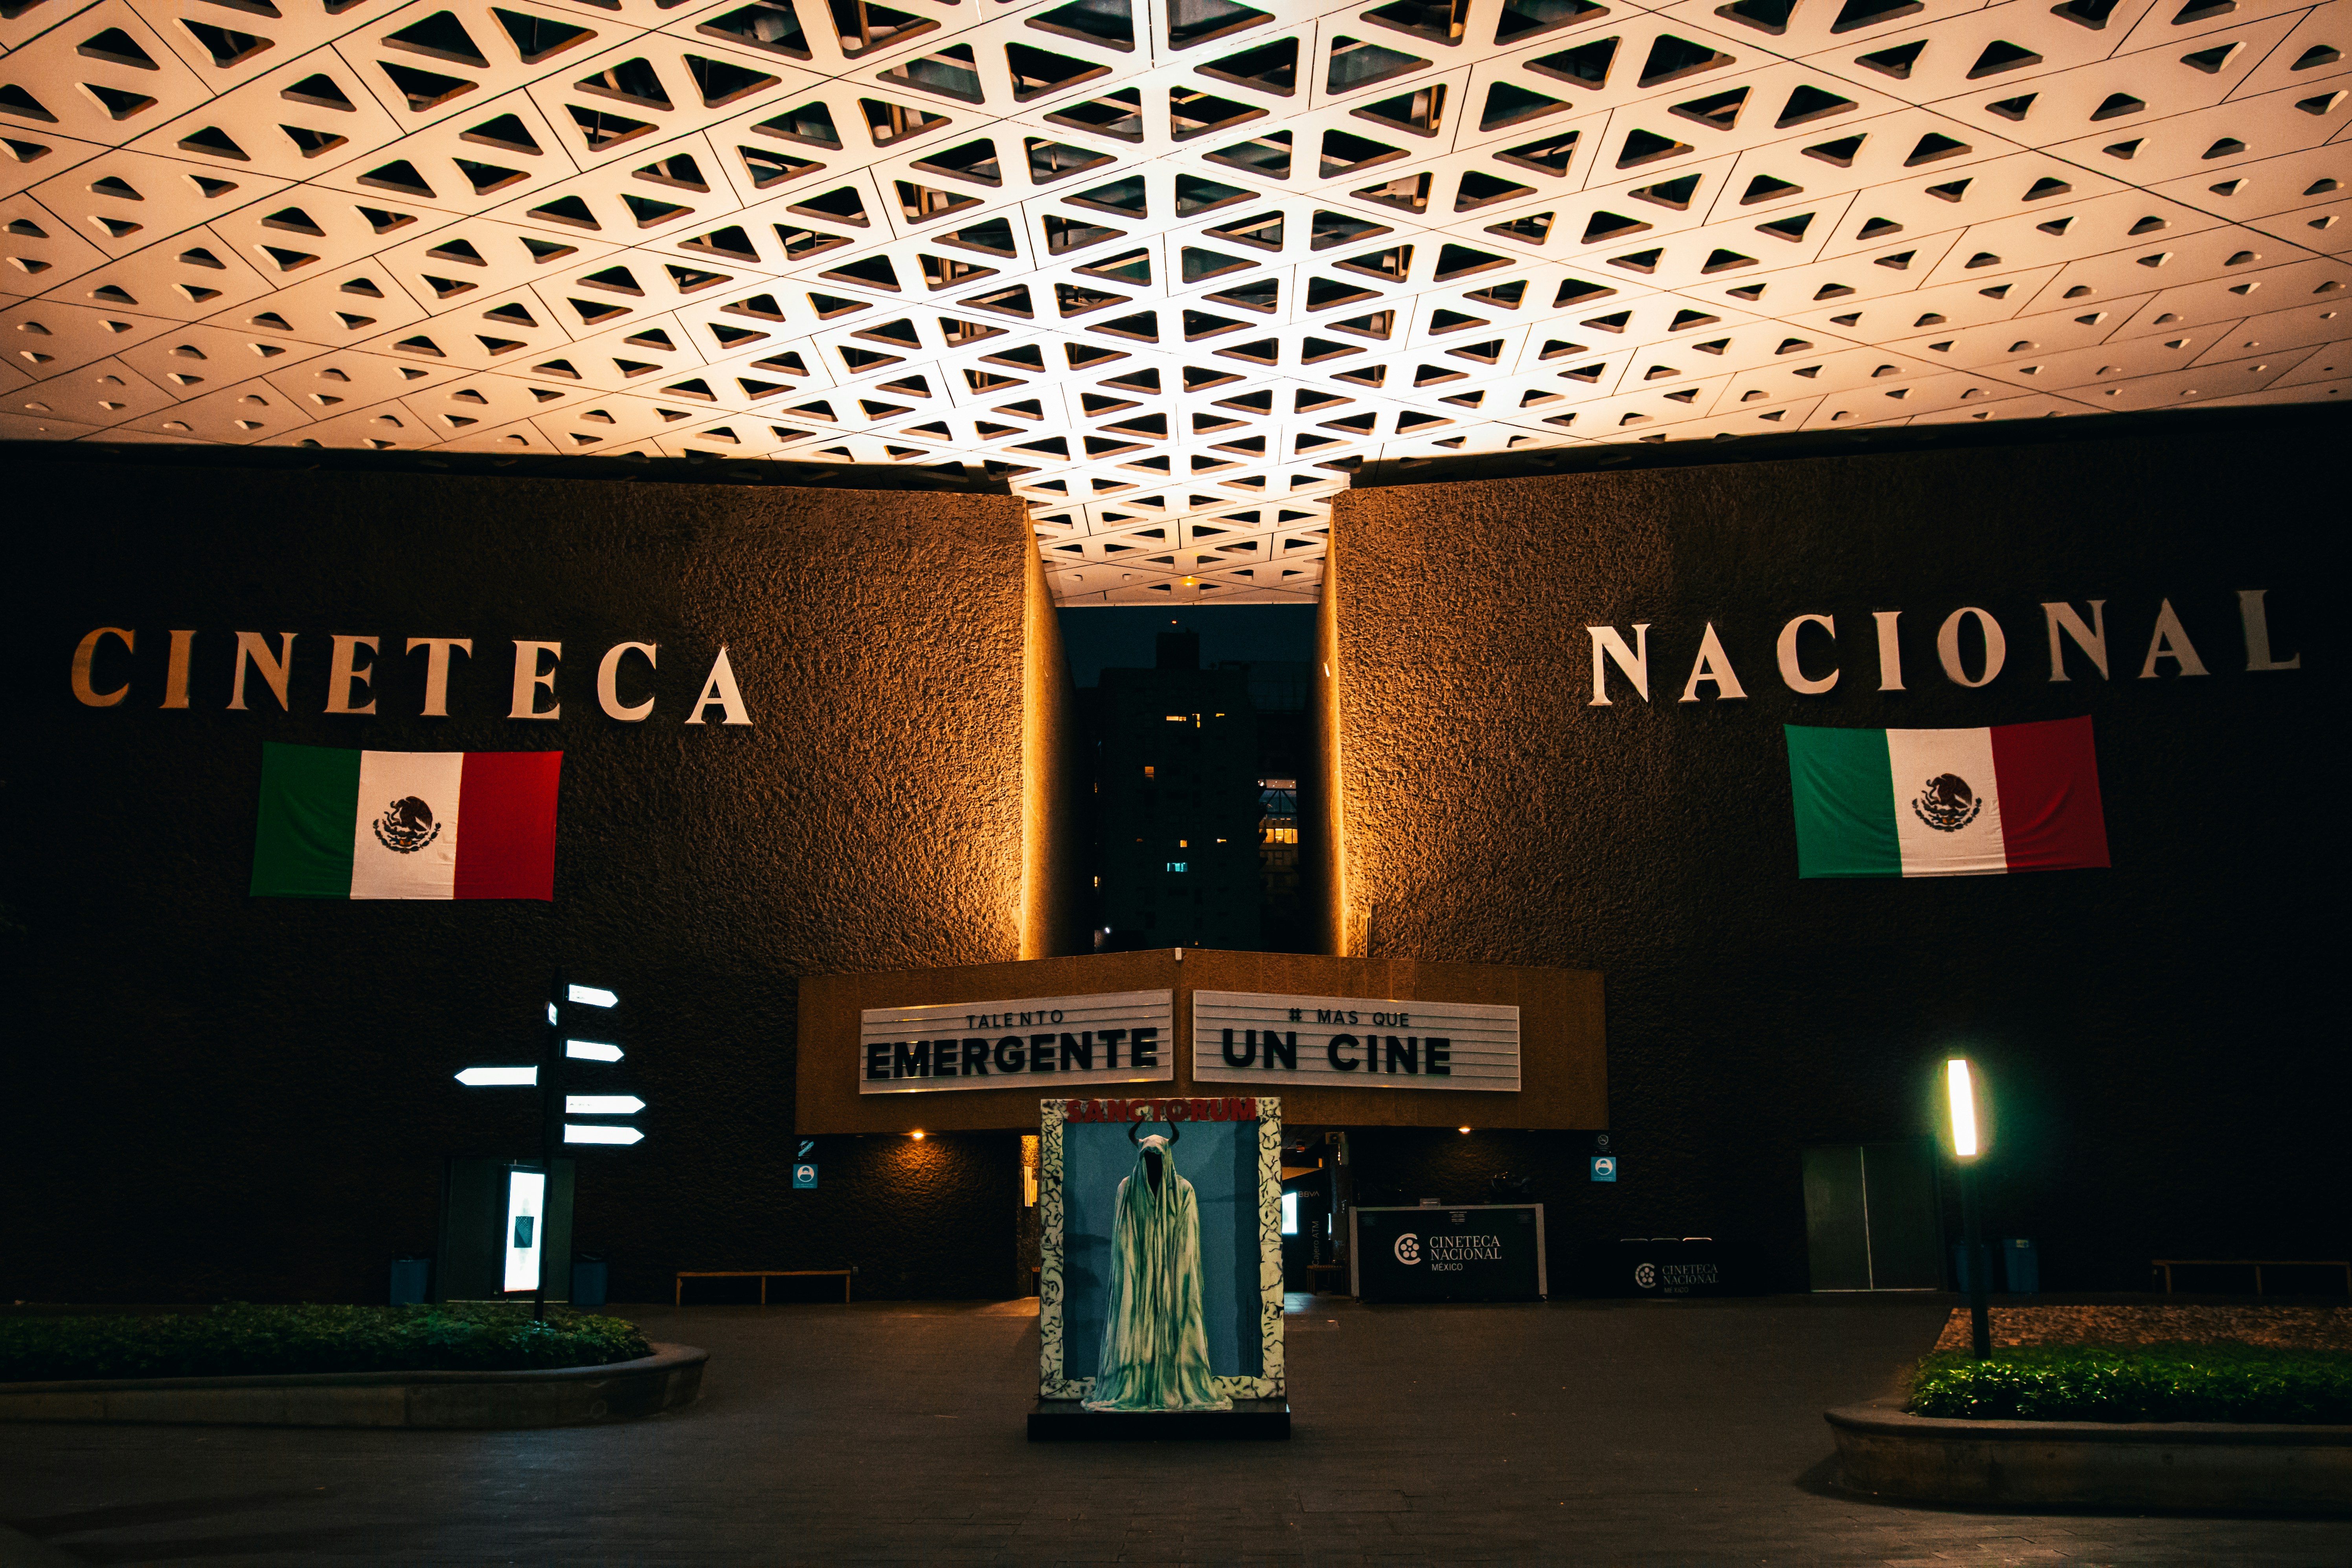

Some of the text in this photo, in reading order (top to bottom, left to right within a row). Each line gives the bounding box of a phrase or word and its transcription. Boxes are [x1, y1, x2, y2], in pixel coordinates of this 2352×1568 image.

[1586, 590, 2302, 706] NACIONAL
[71, 626, 753, 726] CINETECA
[967, 1009, 1064, 1029] TALENTO
[1317, 1009, 1359, 1024] MAS
[1373, 1012, 1409, 1027] QUE
[867, 1027, 1157, 1079] EMERGENTE
[1222, 1028, 1451, 1075] UN CINE
[1066, 1098, 1257, 1123] SANCTORUM
[1429, 1235, 1501, 1248] CINETECA
[1312, 1240, 1320, 1265] Cajero
[1430, 1248, 1502, 1261] NACIONAL
[1431, 1262, 1463, 1271] MÉXICO
[1662, 1263, 1718, 1275] CINETECA
[1663, 1274, 1719, 1285] NACIONAL
